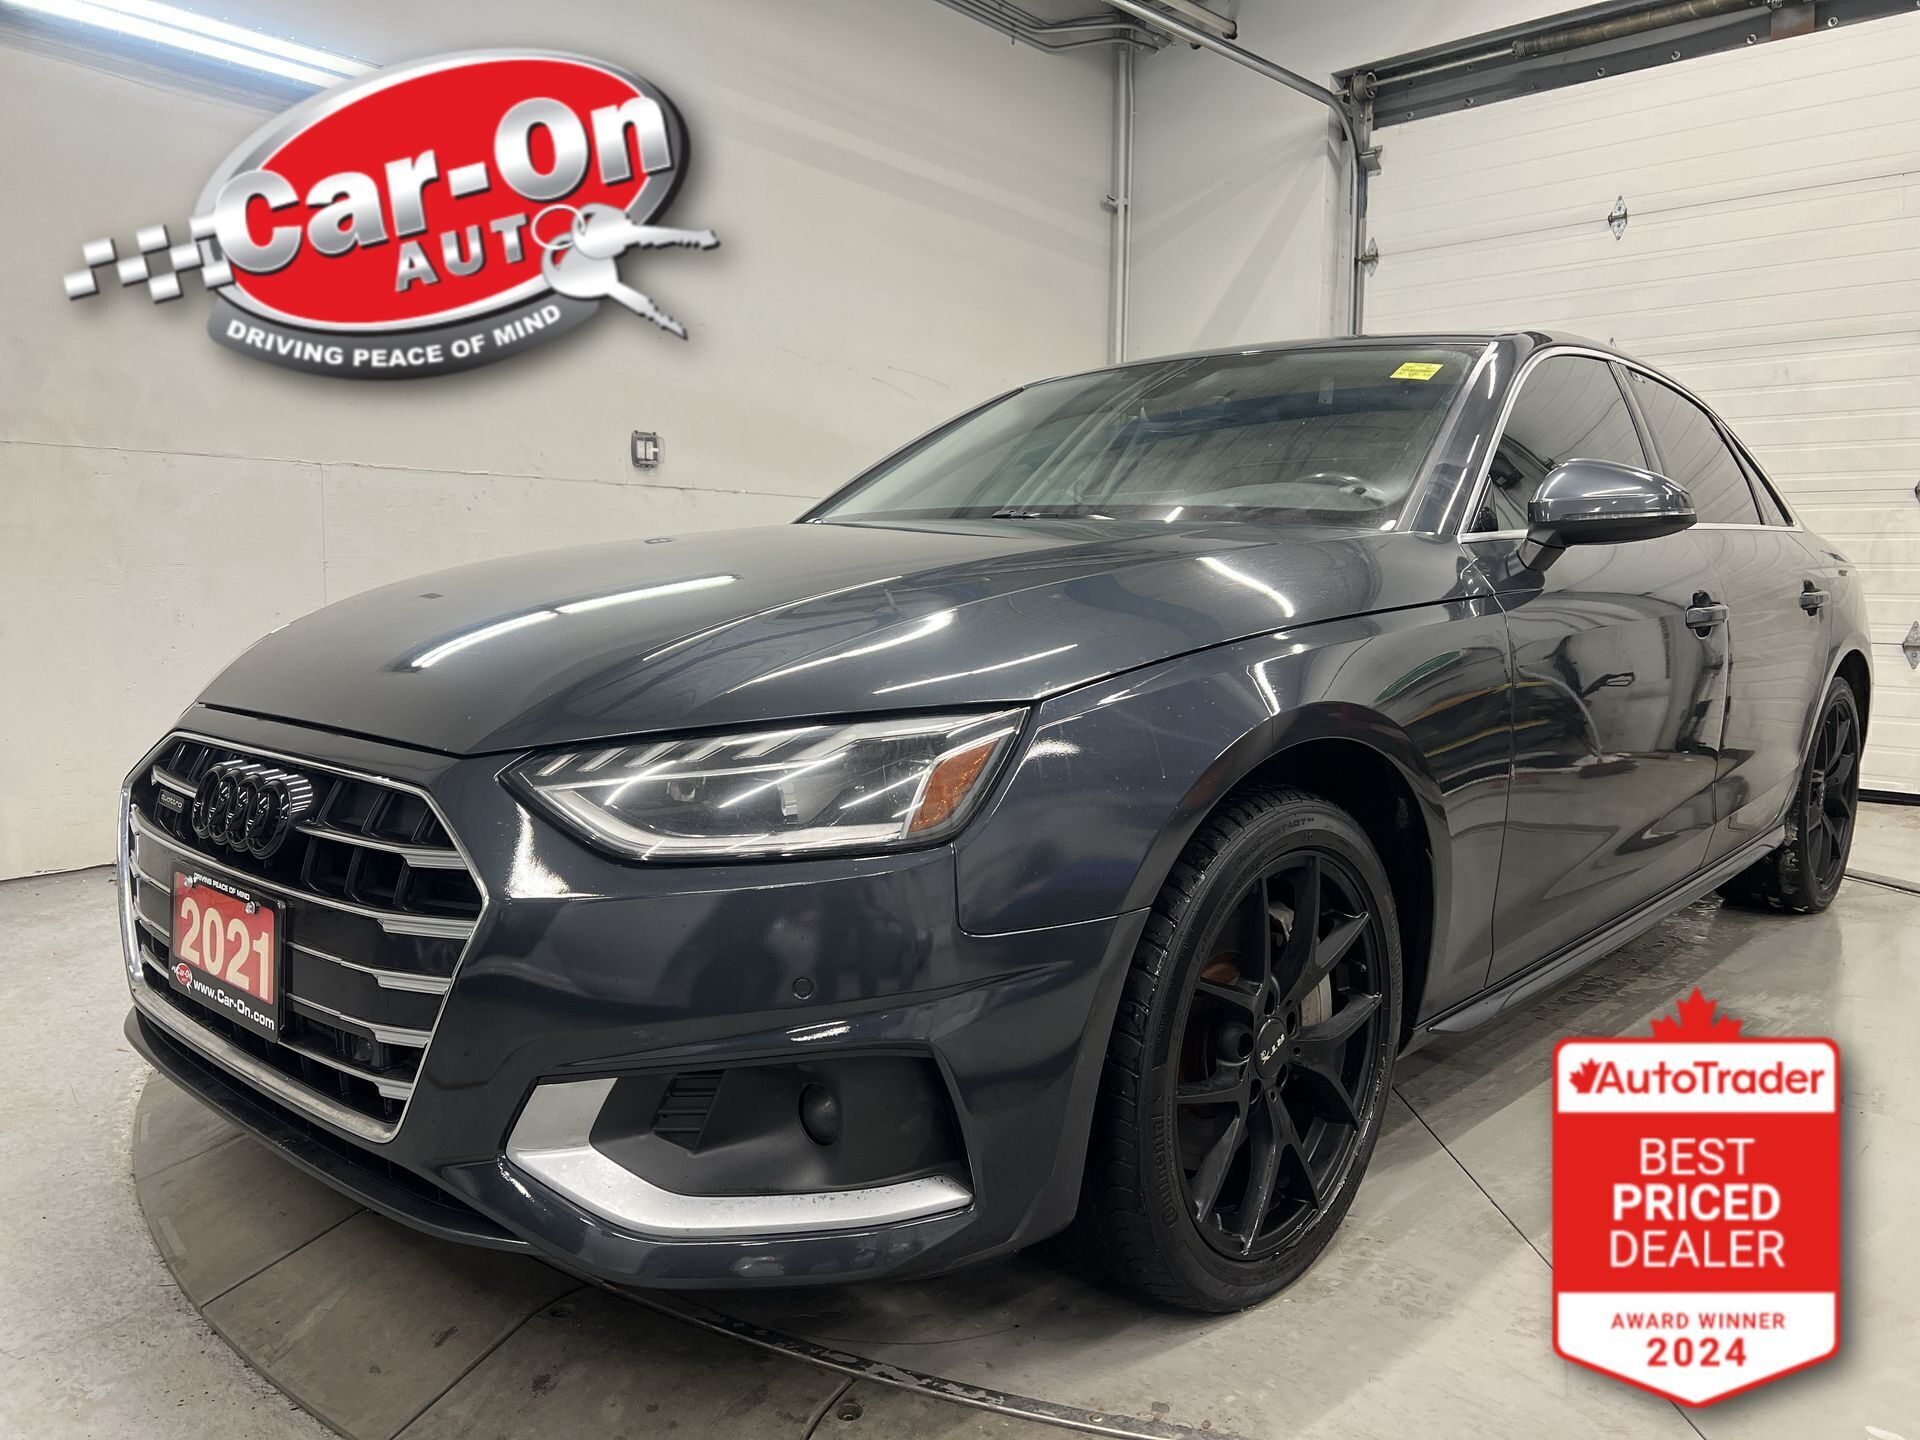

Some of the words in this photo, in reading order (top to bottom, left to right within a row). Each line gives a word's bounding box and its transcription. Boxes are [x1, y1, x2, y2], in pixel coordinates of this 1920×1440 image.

[212, 879, 229, 892] PEACE
[228, 886, 237, 895] OF
[180, 896, 269, 1001] 2021
[193, 979, 275, 1031] www.Car-On.com
